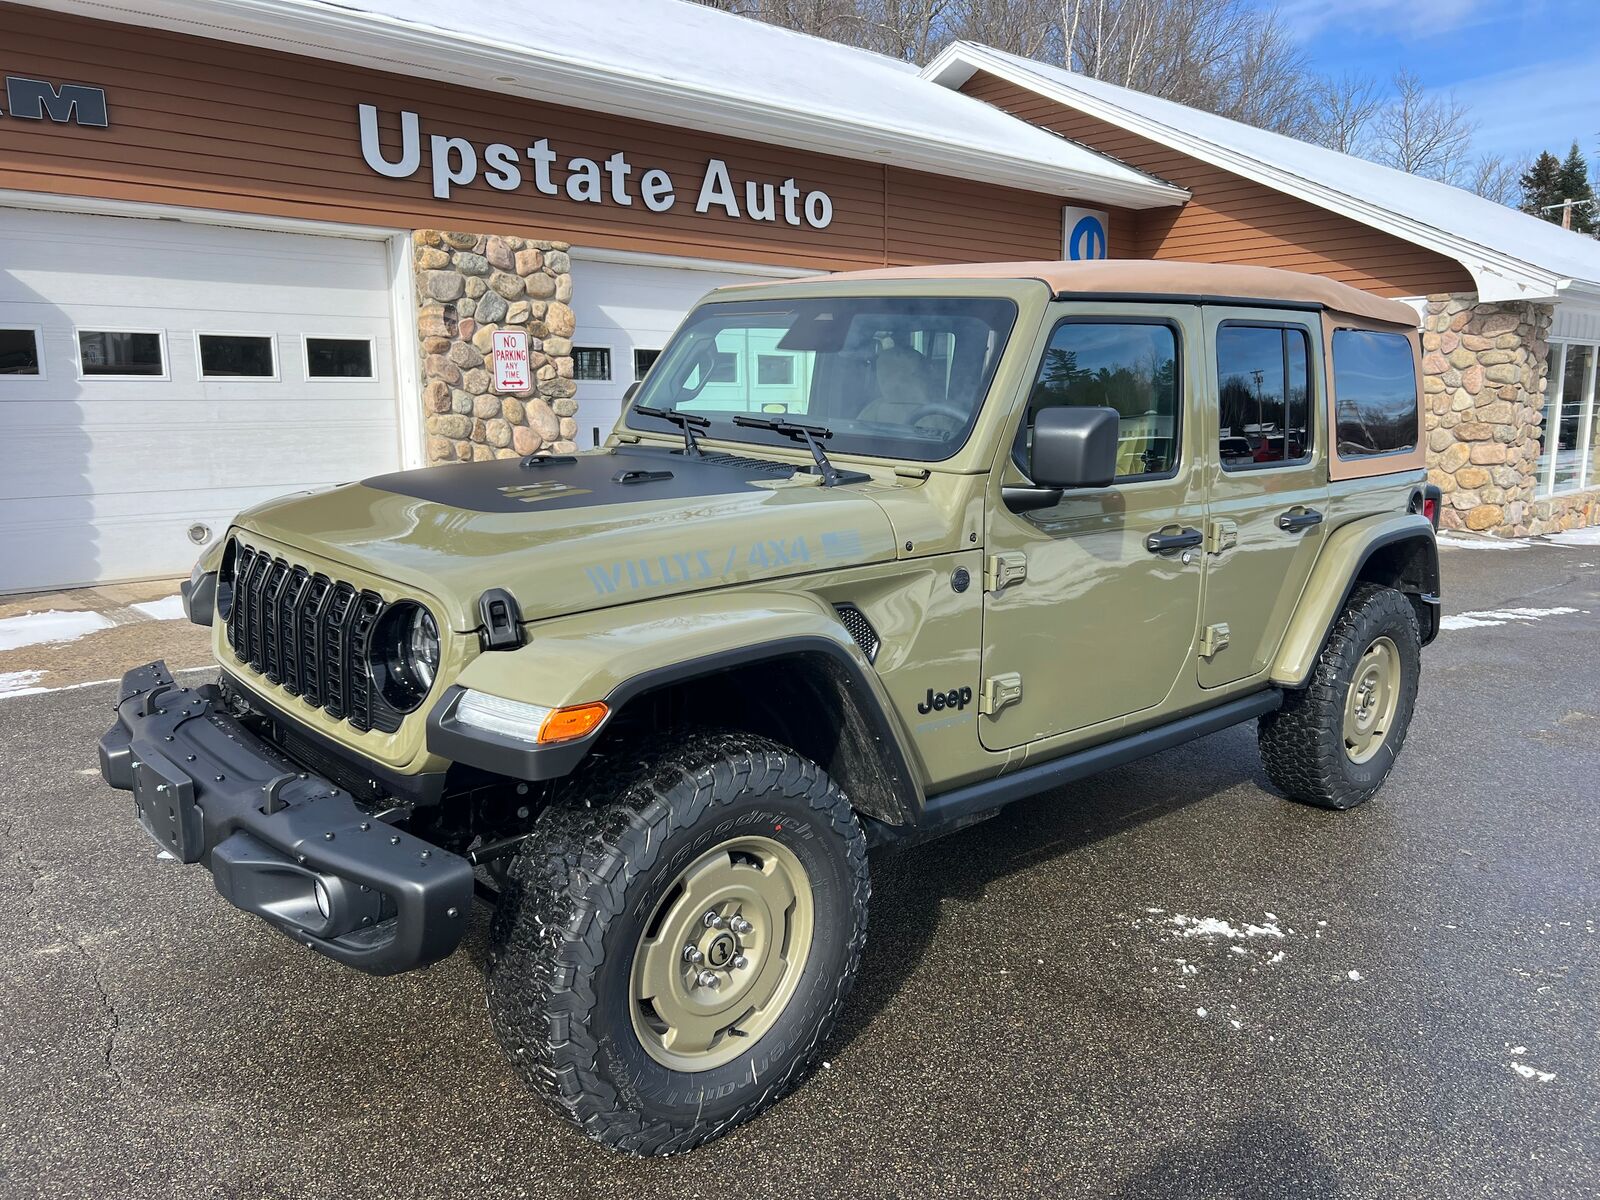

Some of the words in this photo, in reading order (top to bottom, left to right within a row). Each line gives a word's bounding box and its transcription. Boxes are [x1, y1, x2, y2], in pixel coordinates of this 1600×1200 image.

[0, 76, 108, 127] M
[357, 103, 676, 212] Upstate
[695, 158, 834, 230] Auto
[503, 336, 517, 348] NO
[496, 350, 526, 361] PARKING
[504, 370, 520, 379] TIME
[505, 362, 518, 370] ANY
[584, 548, 714, 595] WILLYS
[917, 686, 972, 715] Jeep
